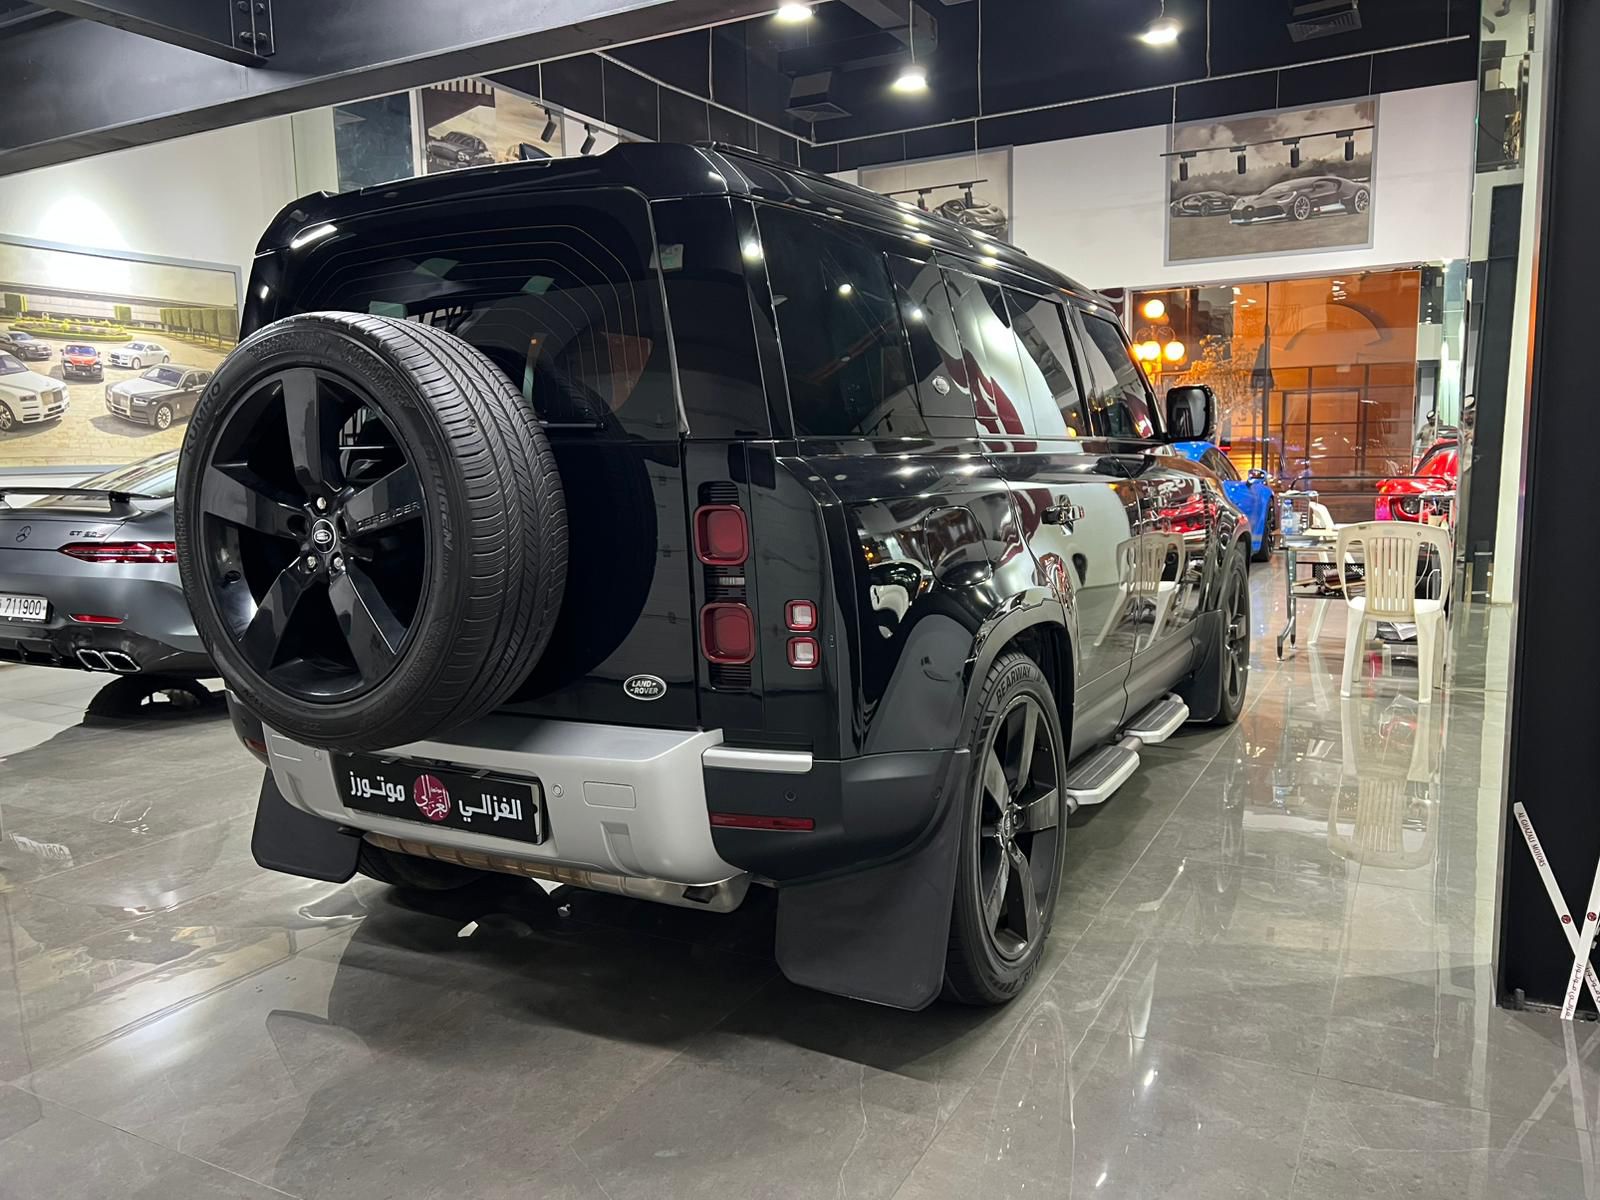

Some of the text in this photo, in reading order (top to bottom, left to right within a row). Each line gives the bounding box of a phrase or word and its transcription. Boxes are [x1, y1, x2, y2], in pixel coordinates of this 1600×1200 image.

[185, 382, 221, 456] KUMHO
[4, 598, 42, 616] 711900
[350, 771, 523, 823] الغزالي موتورز
[1532, 843, 1546, 866] MOTORS
